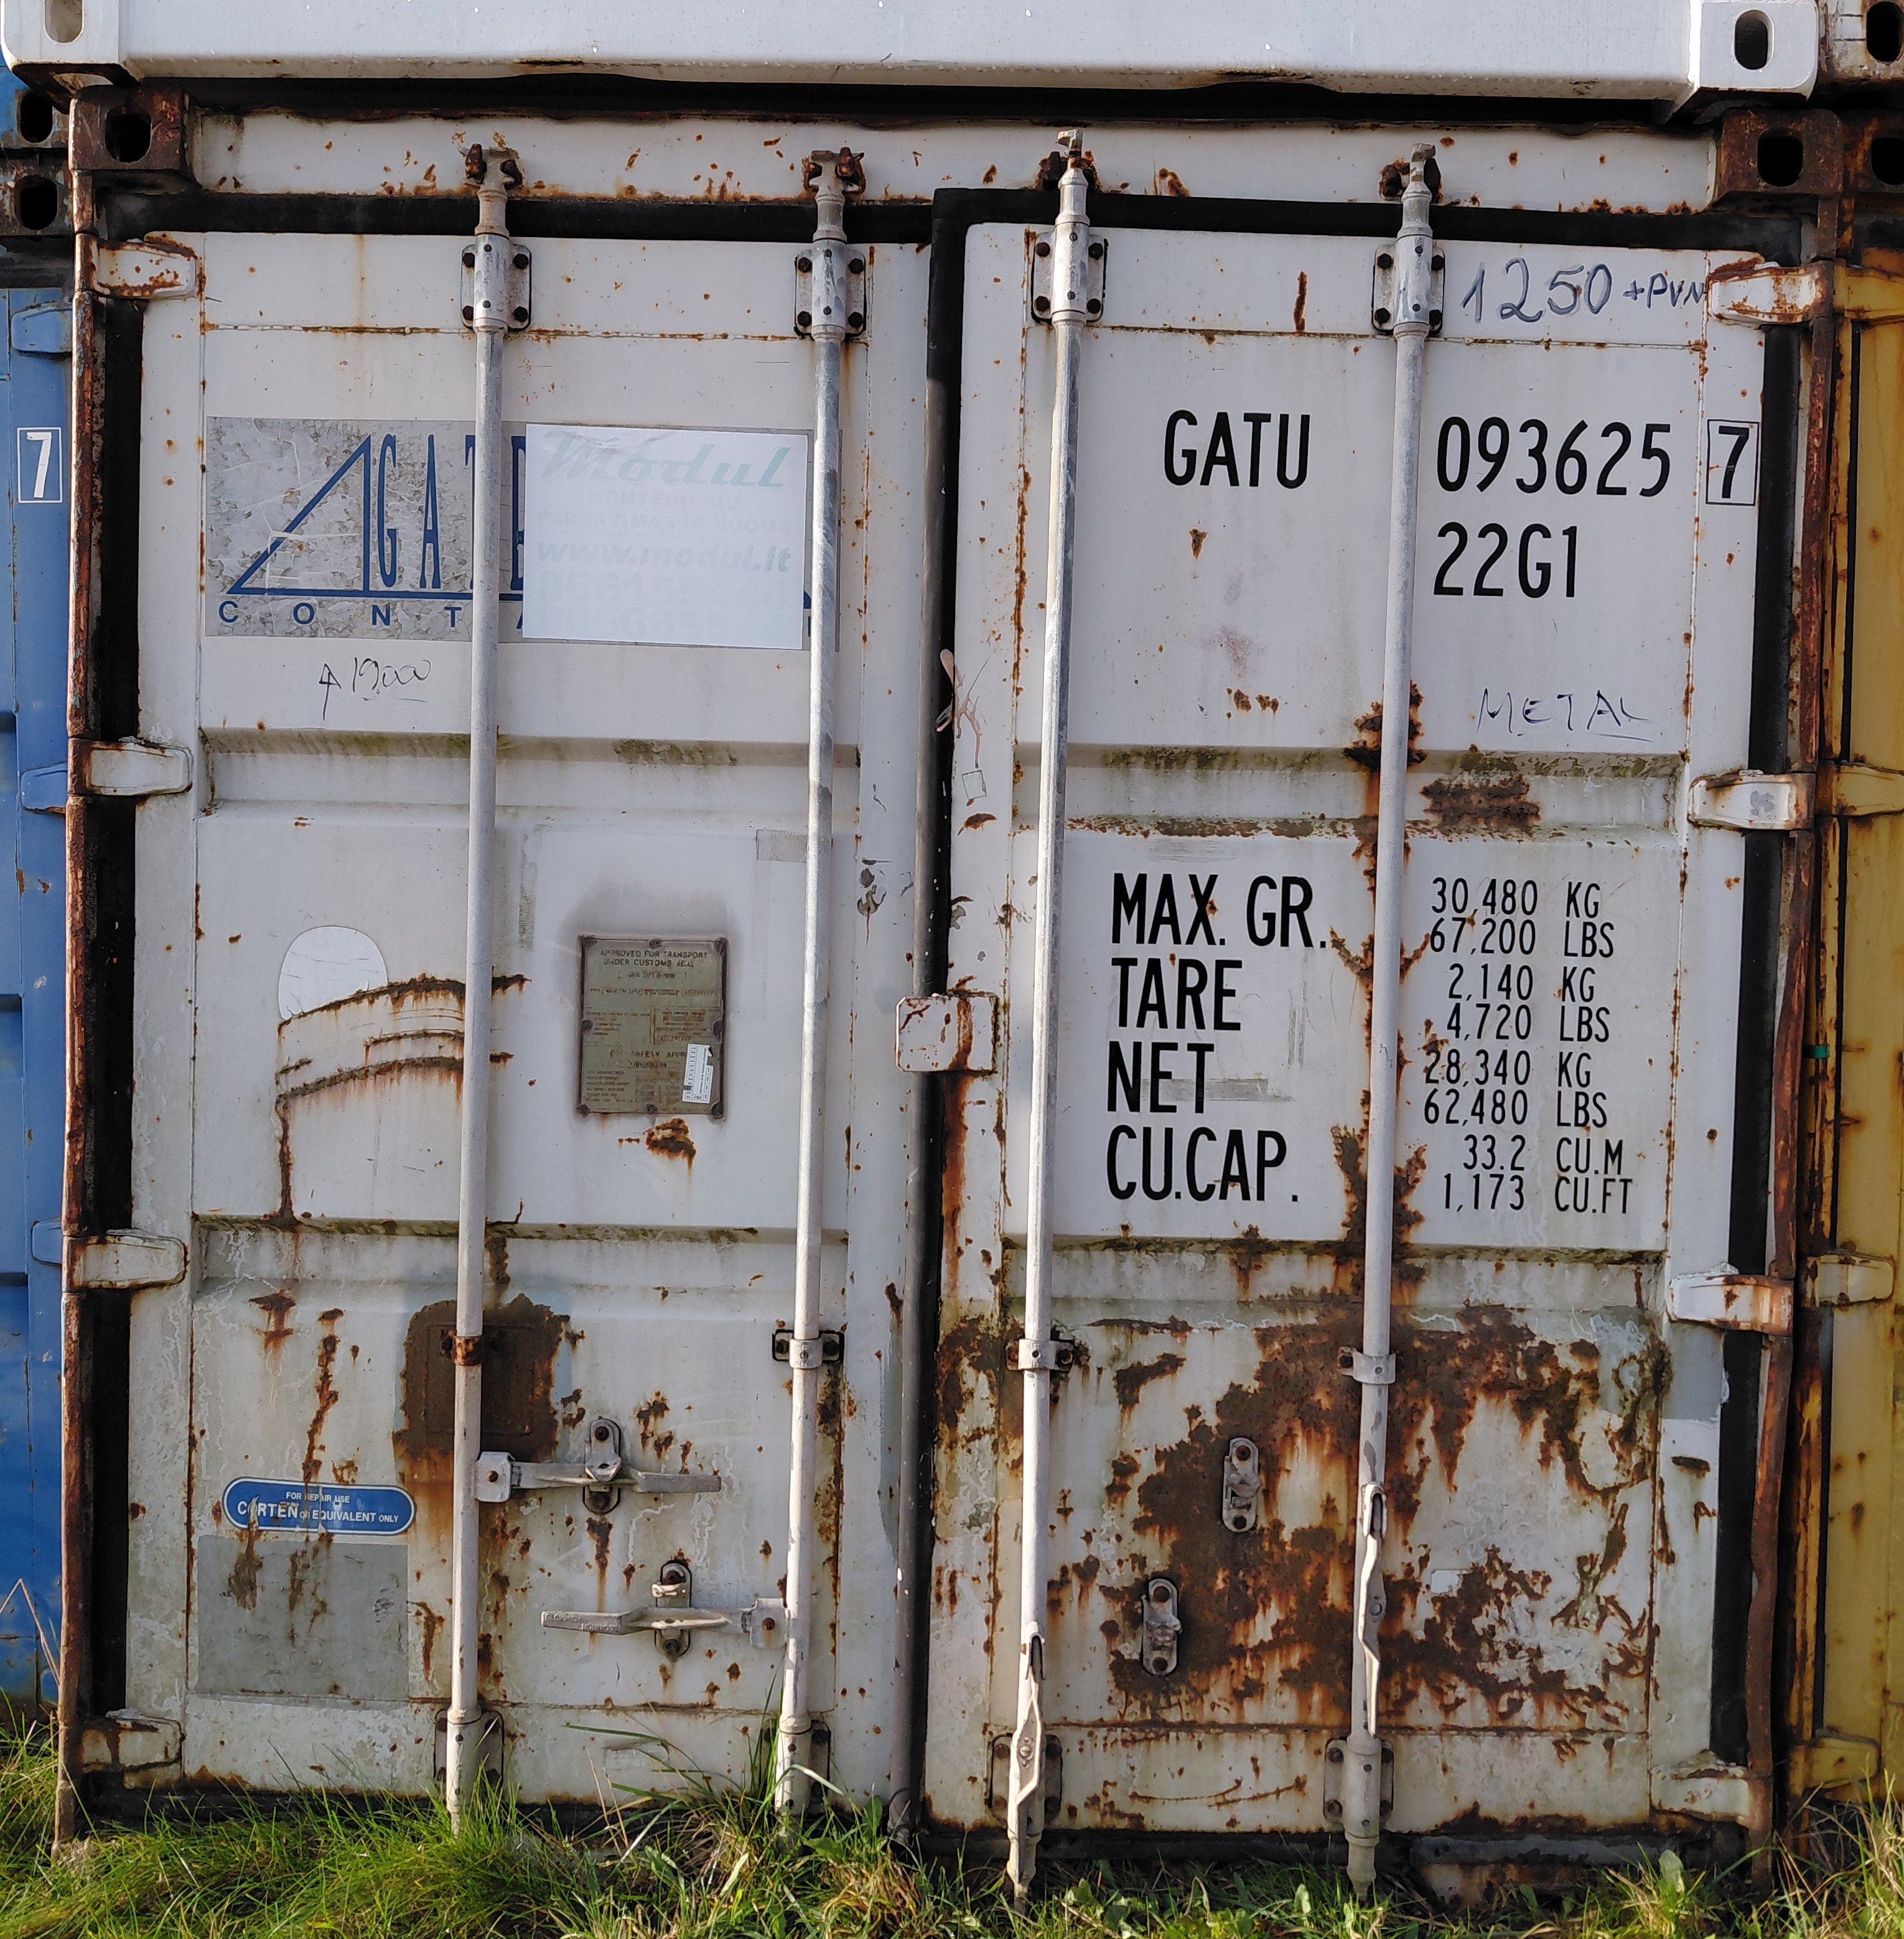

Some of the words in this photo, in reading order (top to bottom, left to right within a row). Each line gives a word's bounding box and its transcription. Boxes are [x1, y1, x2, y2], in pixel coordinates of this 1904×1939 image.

[1460, 257, 1613, 323] 1250
[26, 432, 52, 498] 7
[1164, 409, 1310, 490] GATU
[1436, 416, 1671, 497] 093625
[1718, 425, 1750, 499] 7
[536, 536, 791, 572] www.modul.lt
[1433, 521, 1578, 598] 22G1
[1476, 687, 1649, 734] METAL
[1111, 872, 1226, 946] MAX.
[1246, 875, 1327, 949] GR.
[1431, 877, 1538, 917] 30,480
[1566, 881, 1600, 918] KG
[600, 949, 642, 957] APPROVED
[663, 951, 708, 959] TRANSPORT
[1430, 916, 1536, 956] 67,200
[1563, 921, 1615, 959] LBS
[603, 958, 630, 966] UNDER
[633, 959, 672, 967] CUSTOMS
[1111, 957, 1243, 1031] TARE
[1448, 963, 1533, 1001] 2,140
[1561, 965, 1596, 1003] KG
[1447, 1002, 1532, 1041] 4,720
[1559, 1005, 1610, 1043] LBS
[1107, 1040, 1215, 1114] NET
[1425, 1048, 1531, 1087] 28,340
[1557, 1051, 1591, 1088] KG
[1424, 1088, 1528, 1127] 62,480
[1556, 1090, 1607, 1128] LBS
[1106, 1124, 1299, 1203] CU.CAP.
[1463, 1134, 1526, 1171] 33.2
[1556, 1137, 1623, 1176] CU.M
[1444, 1173, 1524, 1213] 1,173
[1555, 1177, 1633, 1214] CU.FT
[286, 1491, 302, 1500] FOR
[304, 1492, 332, 1503] REPAIR
[334, 1495, 350, 1504] USE
[312, 1509, 377, 1523] EQUIVALENT
[378, 1514, 399, 1523] ONLY
